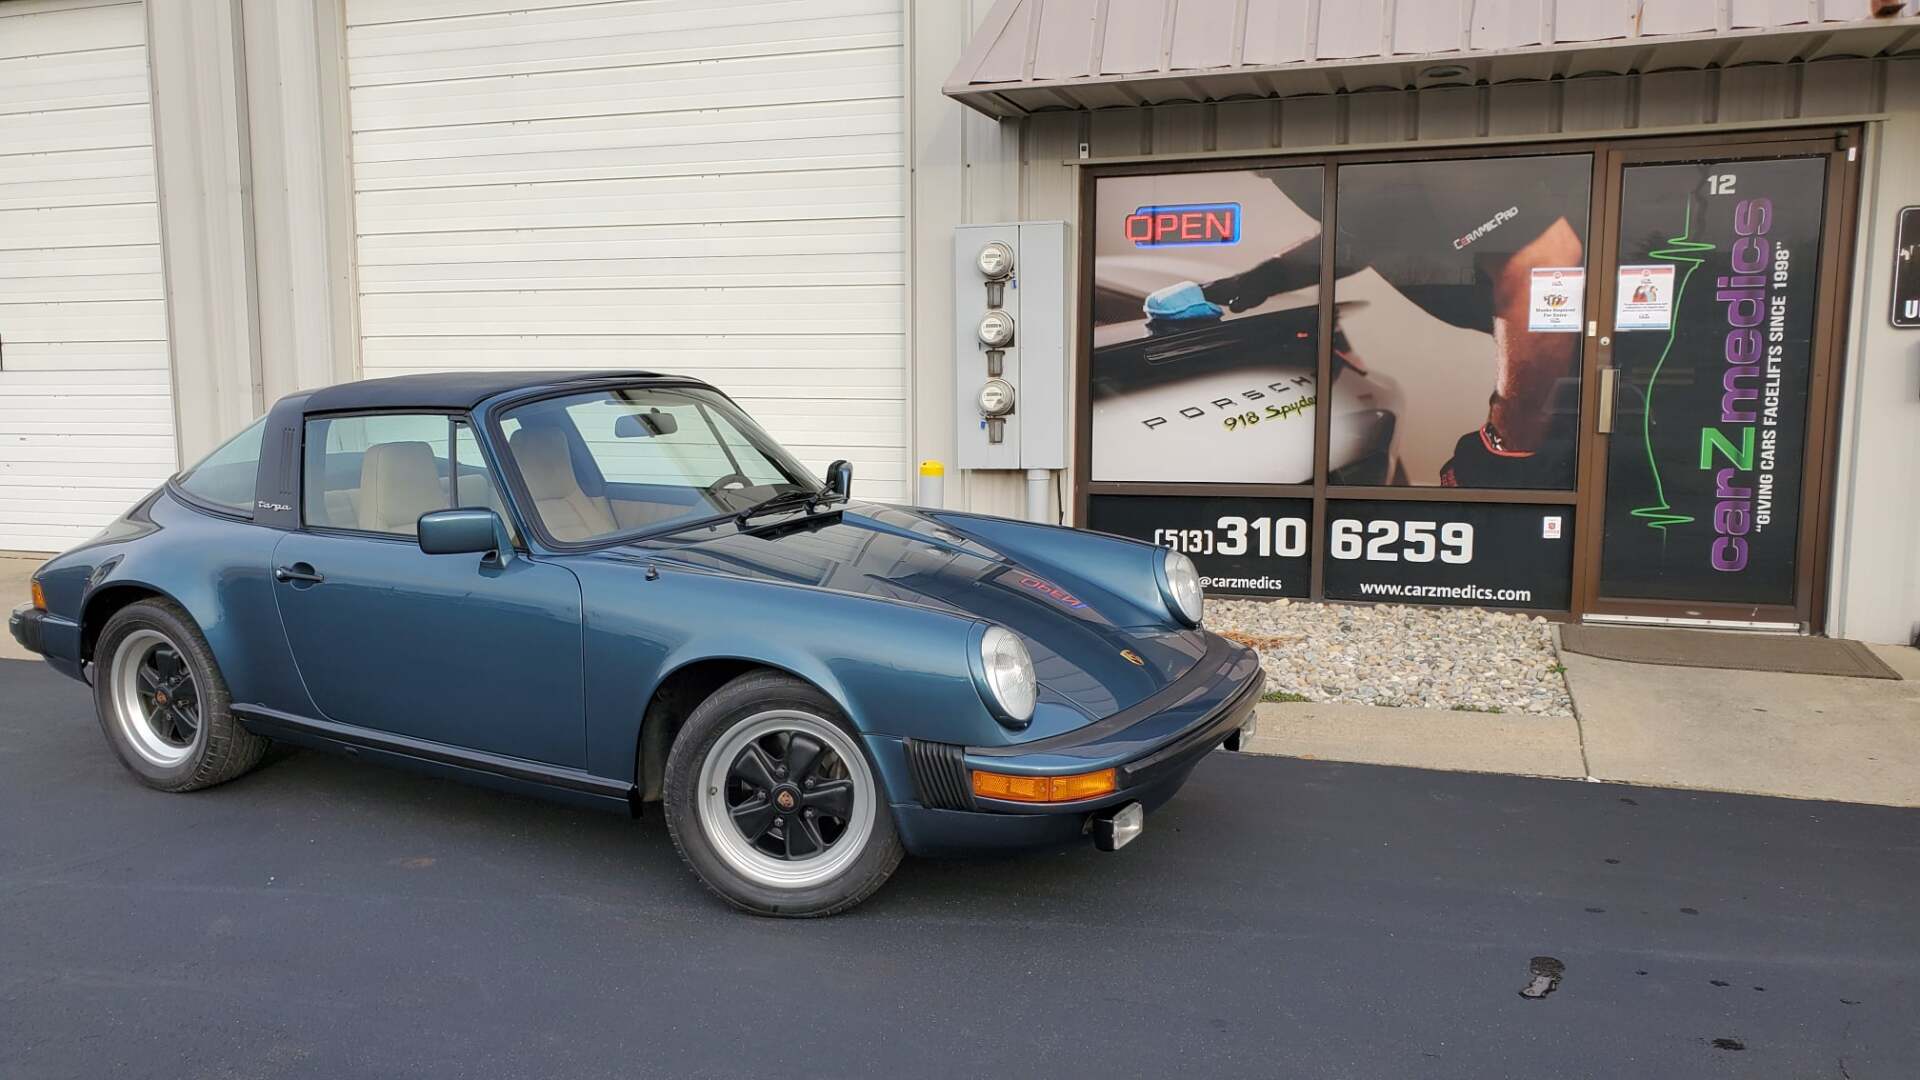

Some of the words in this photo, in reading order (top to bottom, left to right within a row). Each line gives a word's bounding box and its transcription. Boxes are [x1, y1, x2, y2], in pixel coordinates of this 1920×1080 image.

[1707, 174, 1737, 195] 12
[1125, 211, 1233, 241] OPEN
[1768, 296, 1787, 342] SINCE
[1905, 300, 1920, 318] U
[1142, 373, 1316, 429] PORSCH
[1763, 344, 1783, 426] FACELIFTS
[1223, 412, 1260, 431] 918
[1265, 396, 1316, 420] Spyder
[1760, 429, 1777, 471] CARS
[1216, 516, 1307, 557] 310
[1331, 518, 1474, 564] 6259
[1360, 583, 1531, 601] www.carzmedics.com
